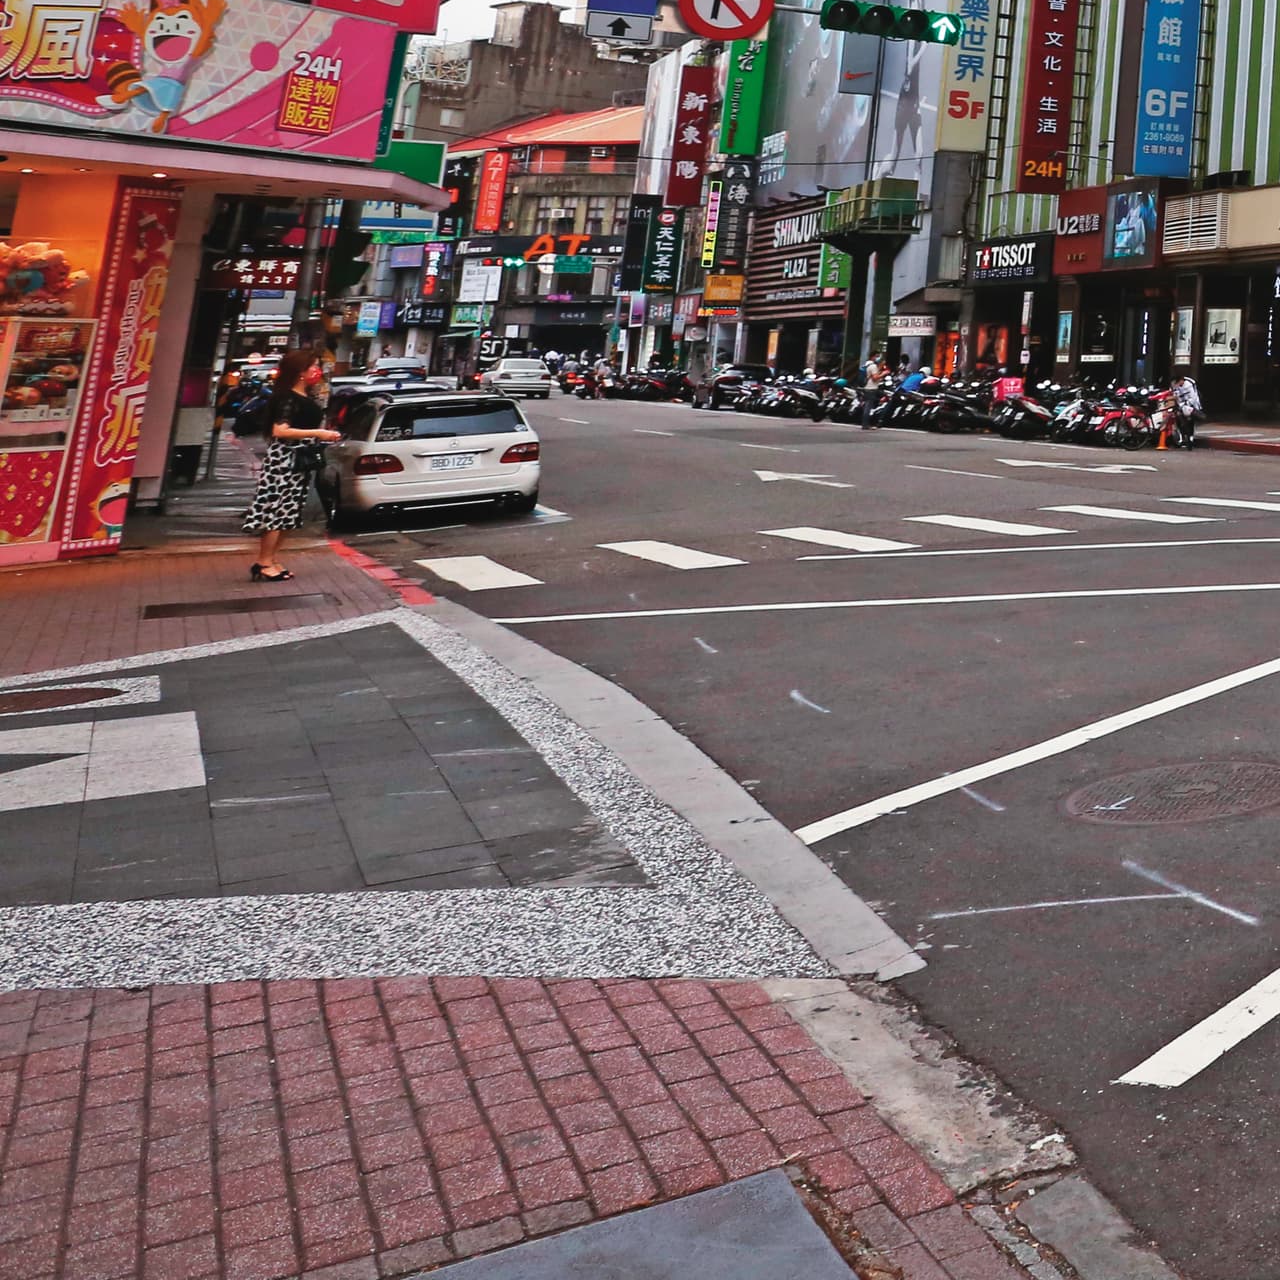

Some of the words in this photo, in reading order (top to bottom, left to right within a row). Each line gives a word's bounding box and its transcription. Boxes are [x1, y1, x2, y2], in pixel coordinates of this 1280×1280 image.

[294, 52, 342, 81] 24H
[730, 77, 743, 120] Shinjuku
[947, 90, 984, 120] 5F
[1144, 89, 1189, 117] 6F
[676, 91, 708, 179] 新東陽
[1024, 160, 1062, 179] 24H
[523, 234, 592, 261] AT
[651, 226, 675, 283] 天仁茗茶
[991, 242, 1036, 269] TISSOT
[783, 258, 807, 278] PLAZA
